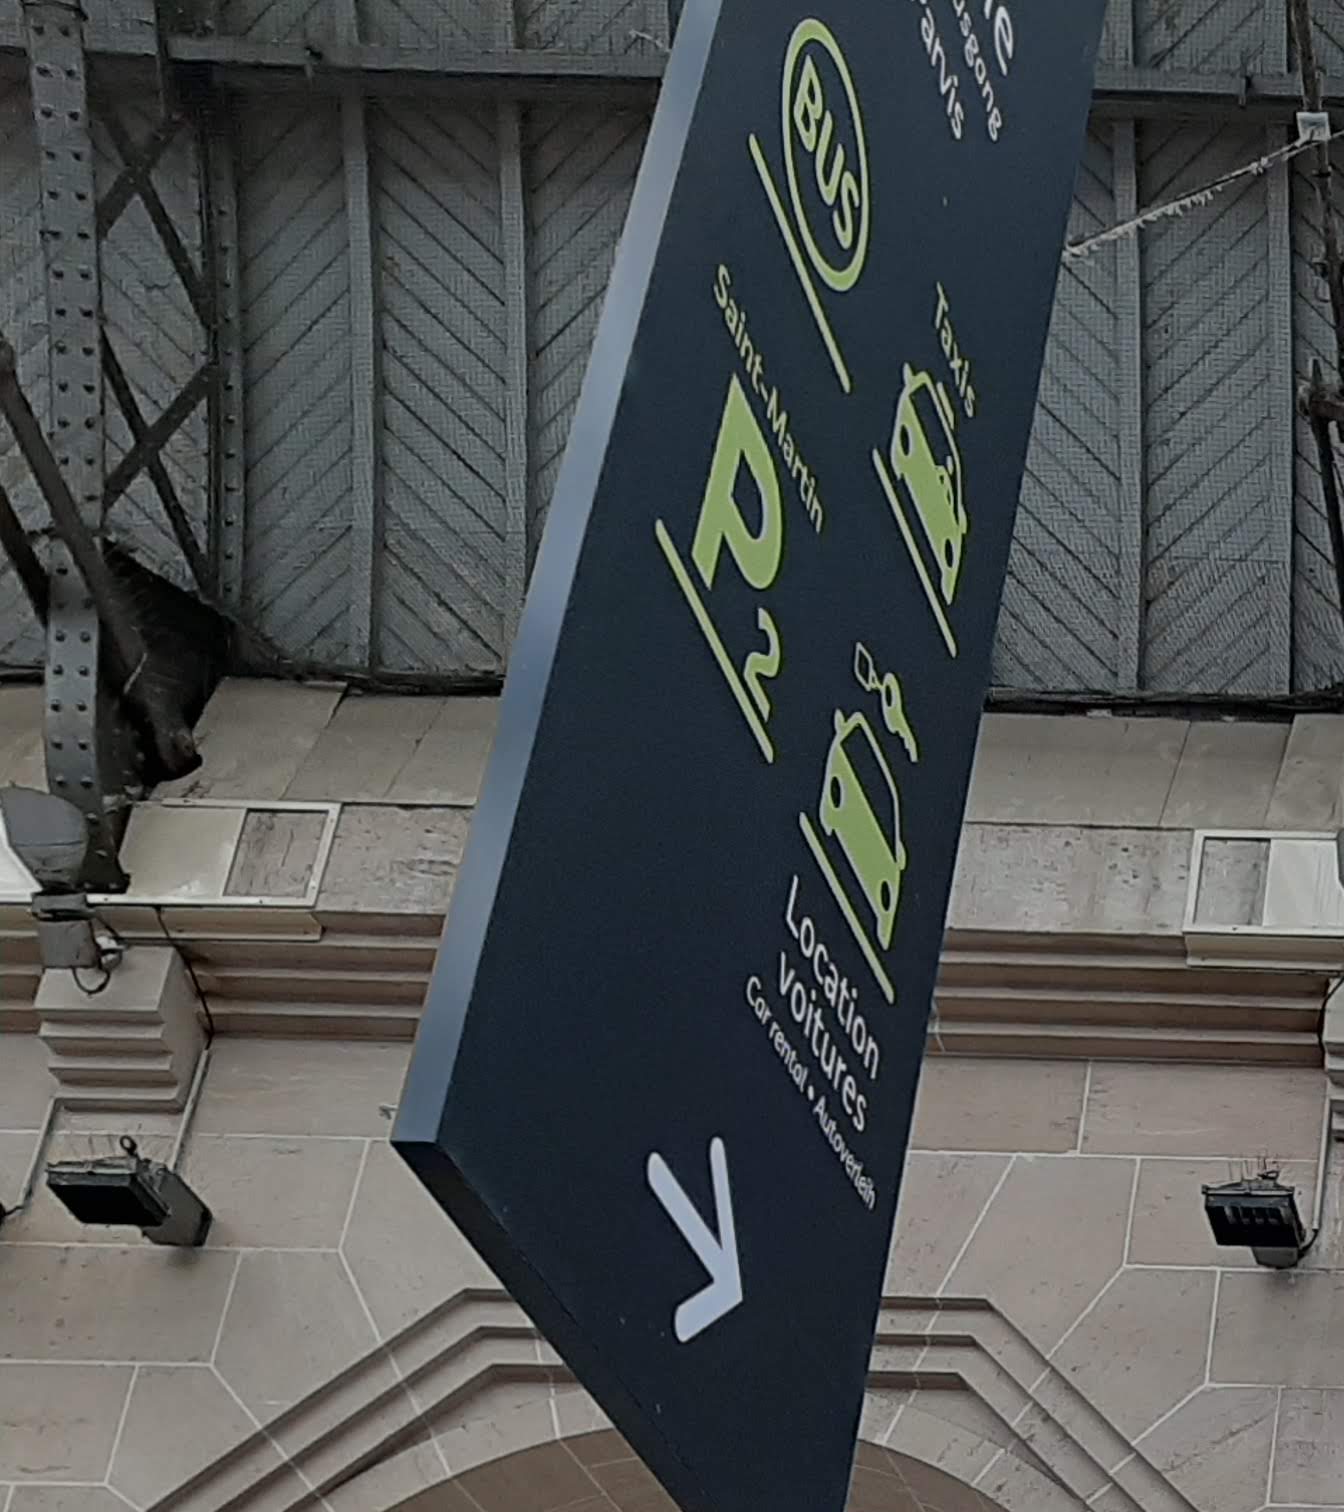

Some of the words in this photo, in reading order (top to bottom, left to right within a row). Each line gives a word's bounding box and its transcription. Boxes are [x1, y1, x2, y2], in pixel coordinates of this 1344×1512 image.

[792, 54, 860, 249] BUS
[912, 0, 964, 139] arvis
[713, 264, 826, 533] Saint-Martin
[934, 281, 976, 418] Taxis
[777, 951, 868, 1132] voitures
[785, 874, 880, 1080] Location
[746, 975, 772, 1026] Car
[768, 1021, 808, 1092] rental
[813, 1095, 877, 1210] Autoverleih
